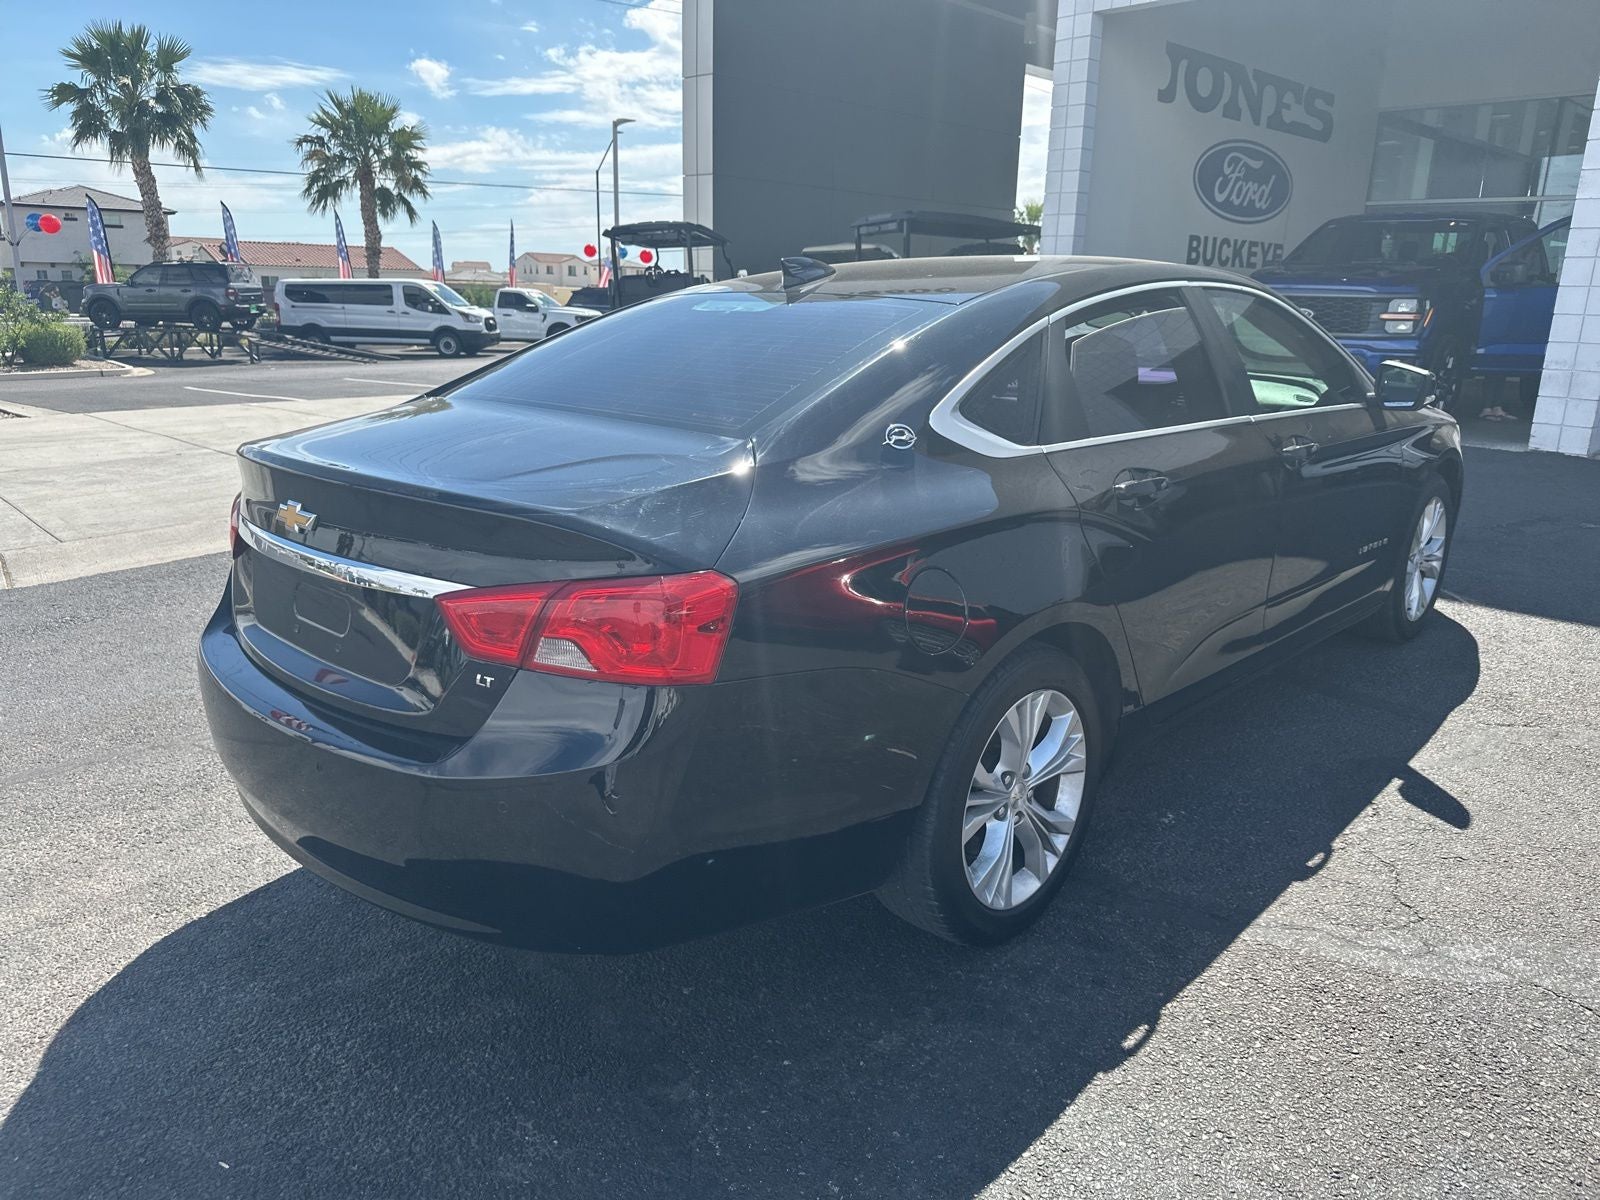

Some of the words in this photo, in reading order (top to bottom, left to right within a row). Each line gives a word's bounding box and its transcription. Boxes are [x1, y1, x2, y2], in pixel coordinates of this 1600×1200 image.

[1157, 40, 1335, 143] JONES
[1214, 152, 1276, 210] Ford
[475, 673, 495, 688] LT
